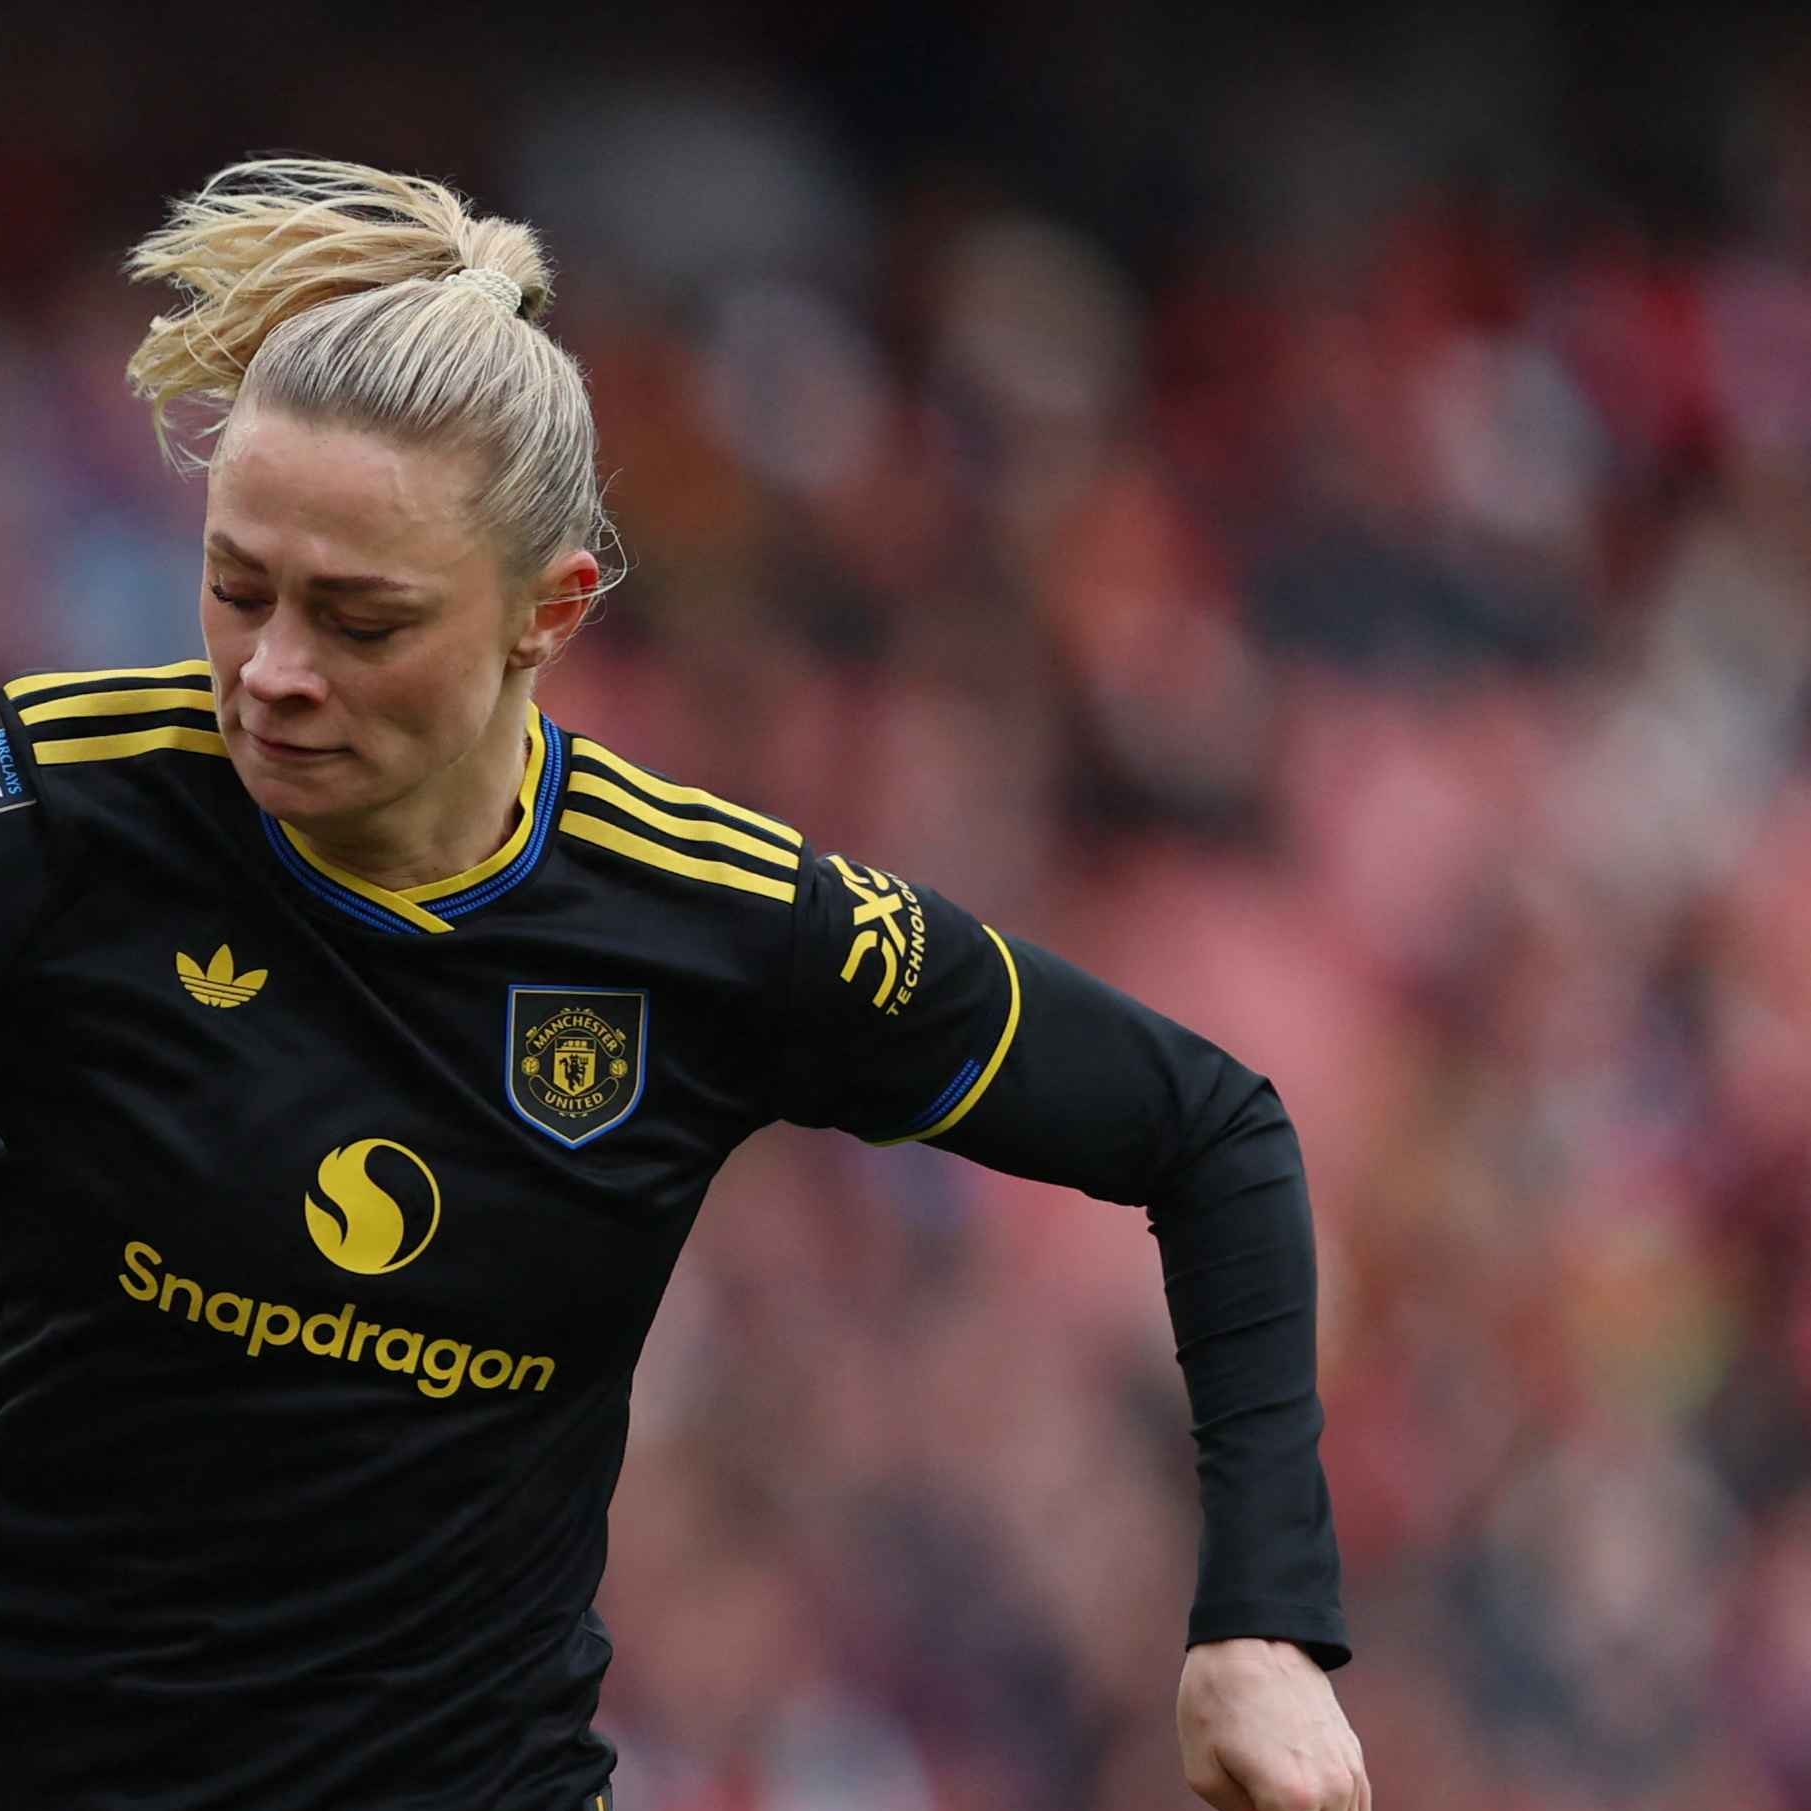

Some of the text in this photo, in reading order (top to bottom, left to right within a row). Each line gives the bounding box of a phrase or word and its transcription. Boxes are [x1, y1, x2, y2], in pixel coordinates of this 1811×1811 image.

[533, 1015, 618, 1051] MANCHESTER
[544, 1091, 604, 1110] UNITED
[118, 1240, 556, 1399] Snapdragon
